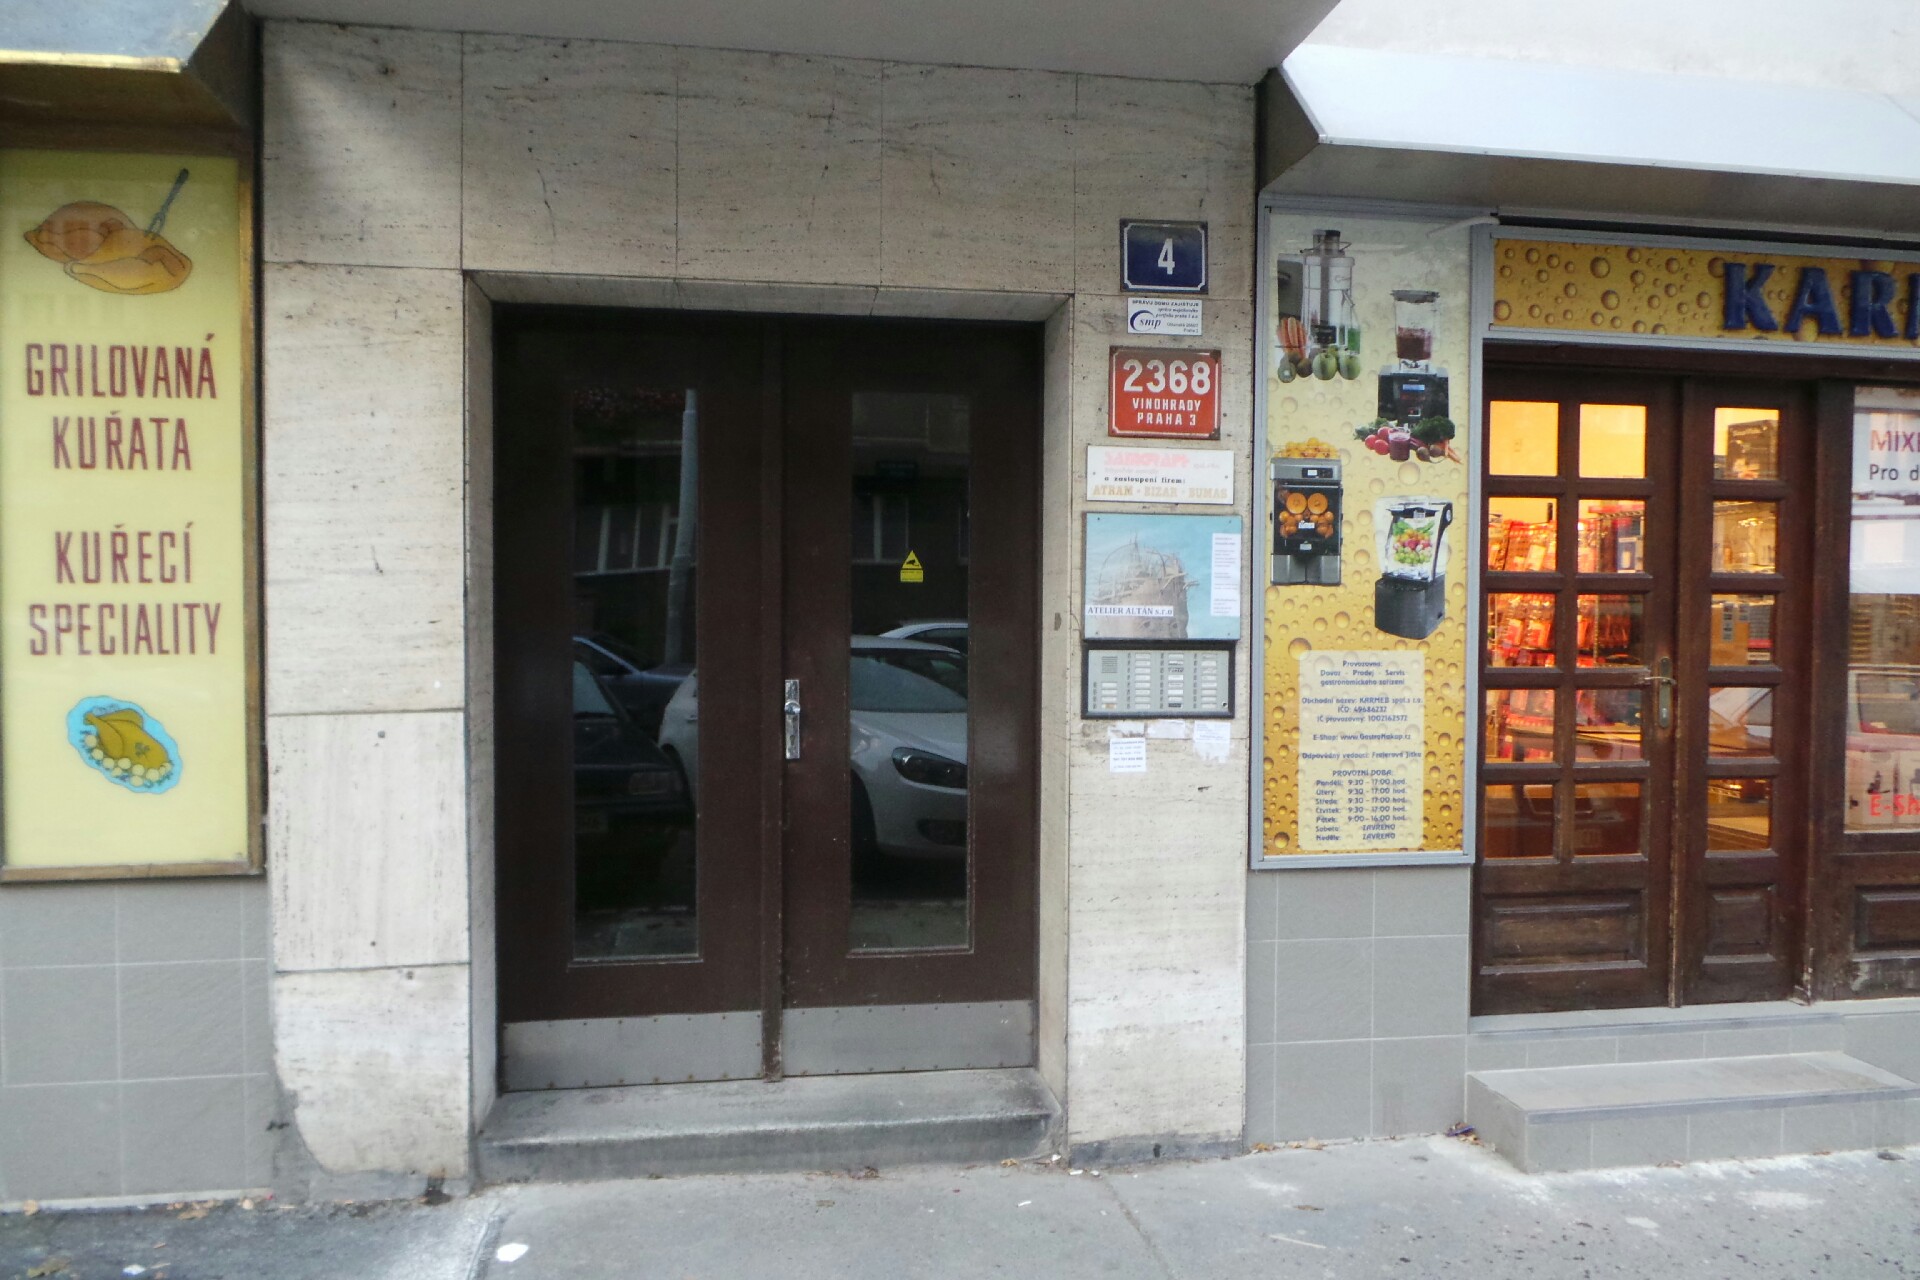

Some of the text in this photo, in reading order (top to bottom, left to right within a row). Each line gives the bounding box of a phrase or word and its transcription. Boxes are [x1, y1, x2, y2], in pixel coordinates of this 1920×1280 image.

[1157, 238, 1176, 275] 4
[1723, 262, 1920, 340] KAR
[1139, 318, 1162, 330] smp
[26, 333, 217, 399] GRILOVANÁ
[1122, 359, 1211, 396] 2368
[1132, 398, 1201, 412] VINOHRADY
[1137, 412, 1196, 426] PRAHA 3
[53, 409, 191, 471] KUŘATA
[1114, 475, 1158, 484] zastoupení
[1869, 463, 1899, 481] Pro
[55, 522, 193, 583] KUŘECÍ
[1087, 606, 1124, 615] ATELIER
[29, 603, 220, 657] SPECIALITY
[1352, 669, 1375, 678] Prodej
[1312, 734, 1338, 742] E-Shop:
[1332, 768, 1369, 777] PROVOZNÍ
